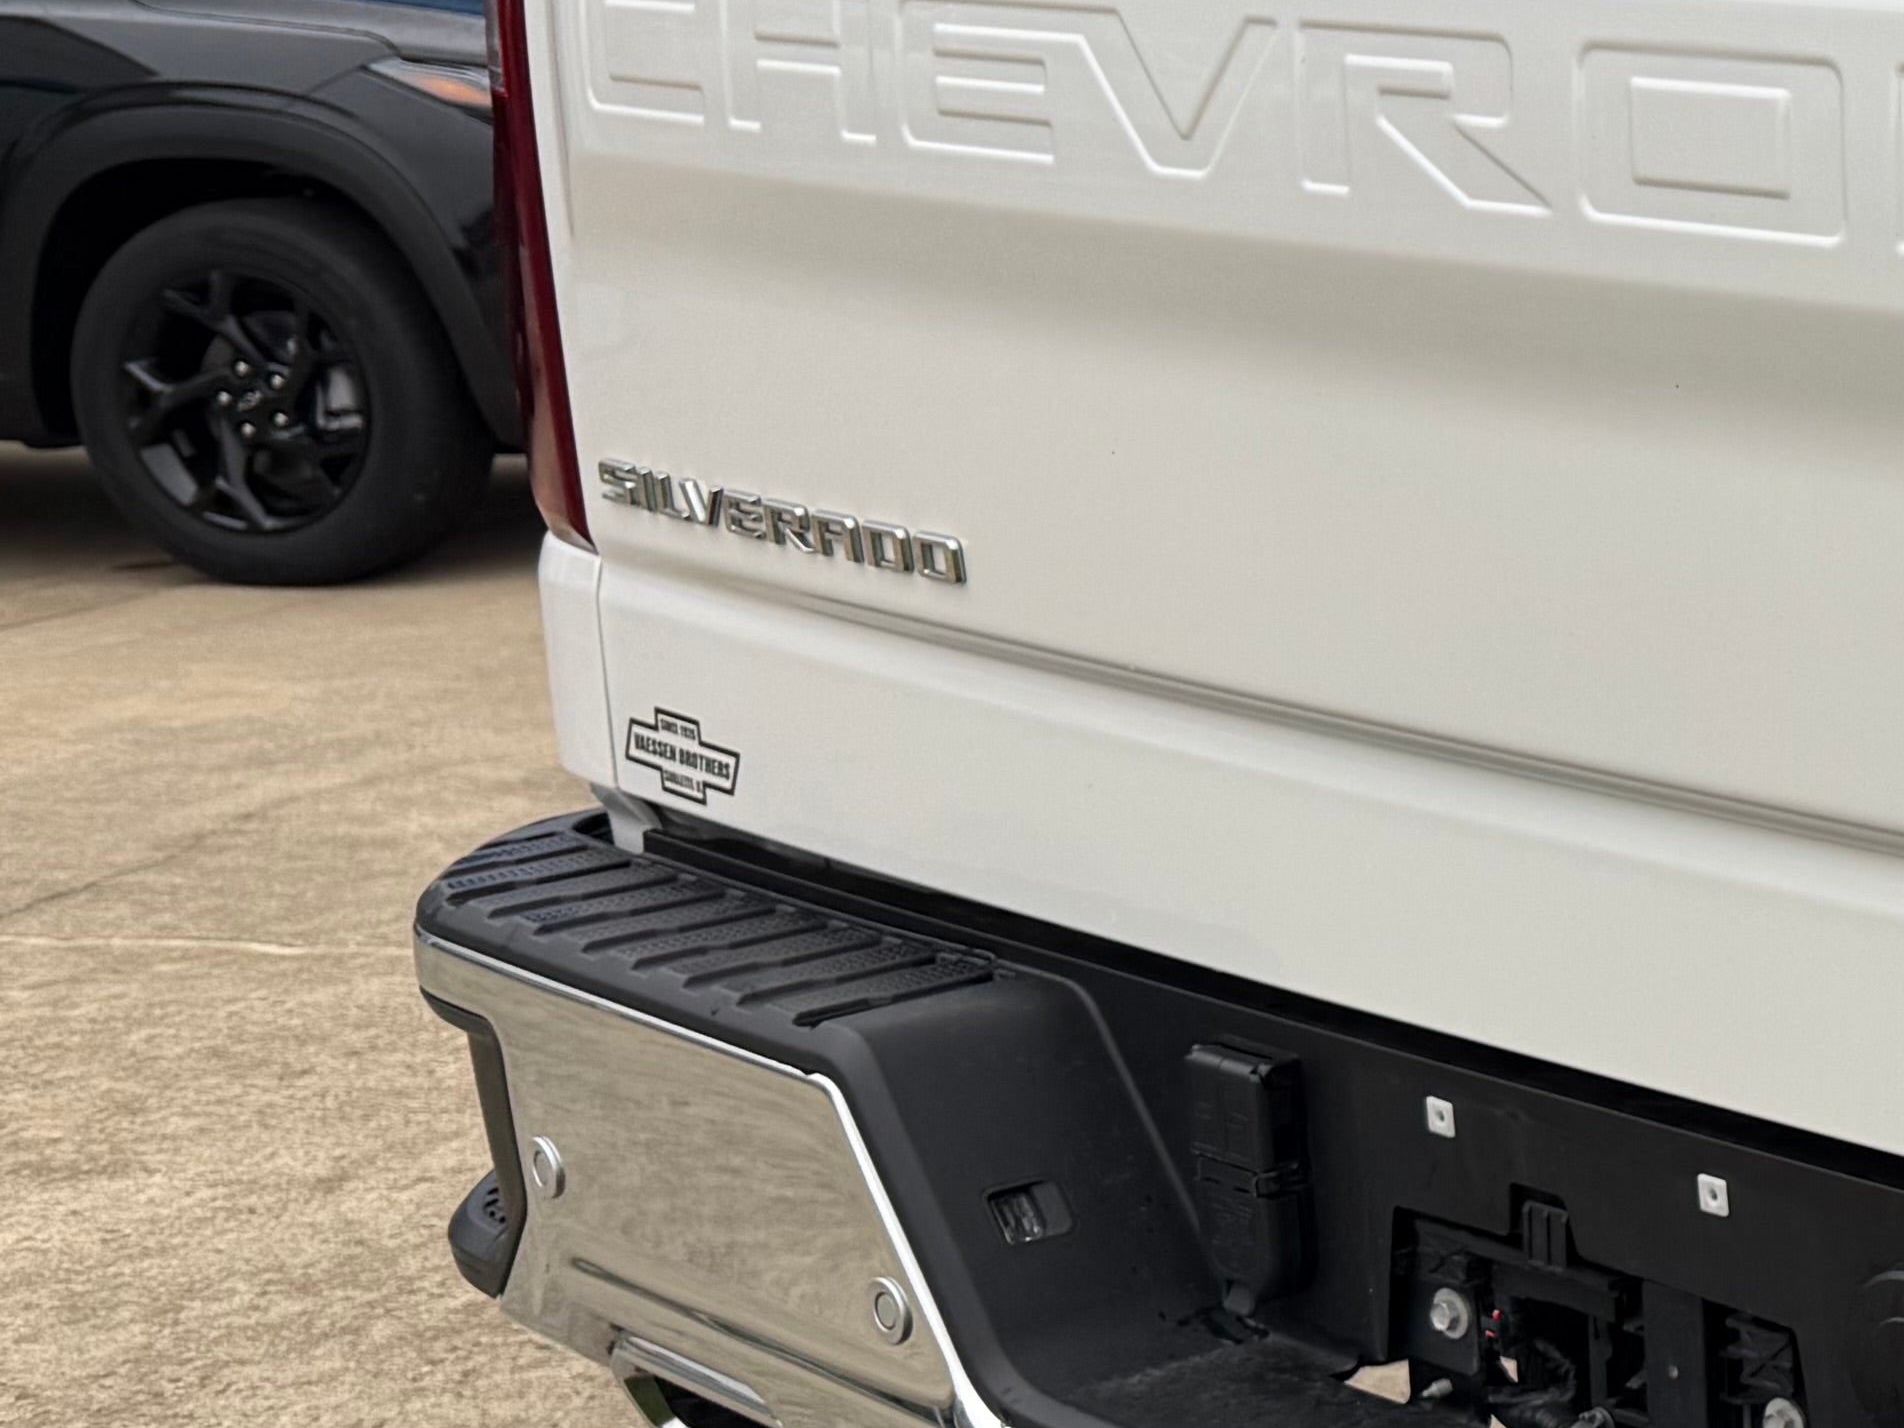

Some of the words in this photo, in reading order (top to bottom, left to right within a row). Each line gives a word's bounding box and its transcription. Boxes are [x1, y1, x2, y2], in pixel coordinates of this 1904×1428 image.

[597, 457, 968, 585] SILVERADO
[633, 731, 677, 762] VAESSEN
[678, 747, 731, 781] BROTHERS
